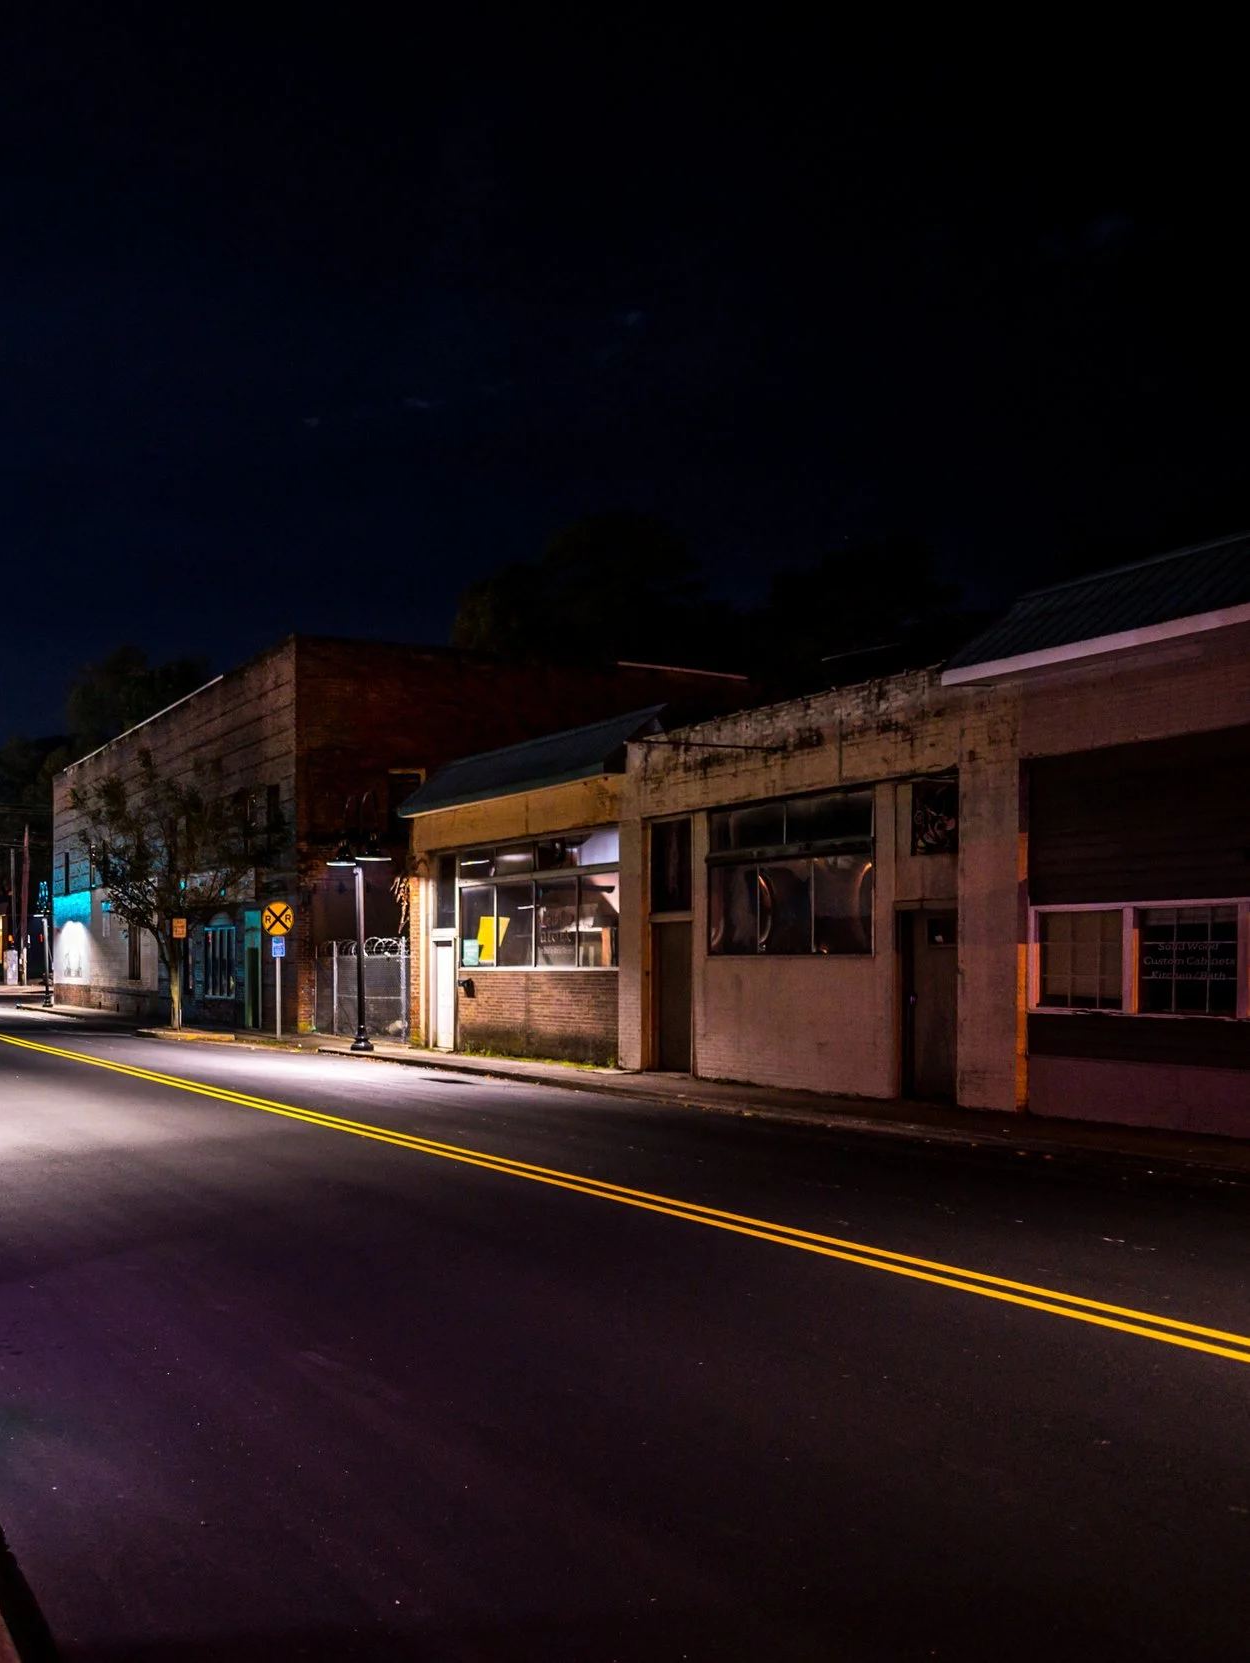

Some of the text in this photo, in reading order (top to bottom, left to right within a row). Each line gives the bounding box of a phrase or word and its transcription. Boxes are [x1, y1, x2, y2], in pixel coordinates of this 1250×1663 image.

[265, 914, 291, 923] R R
[1143, 956, 1185, 965] Custom
